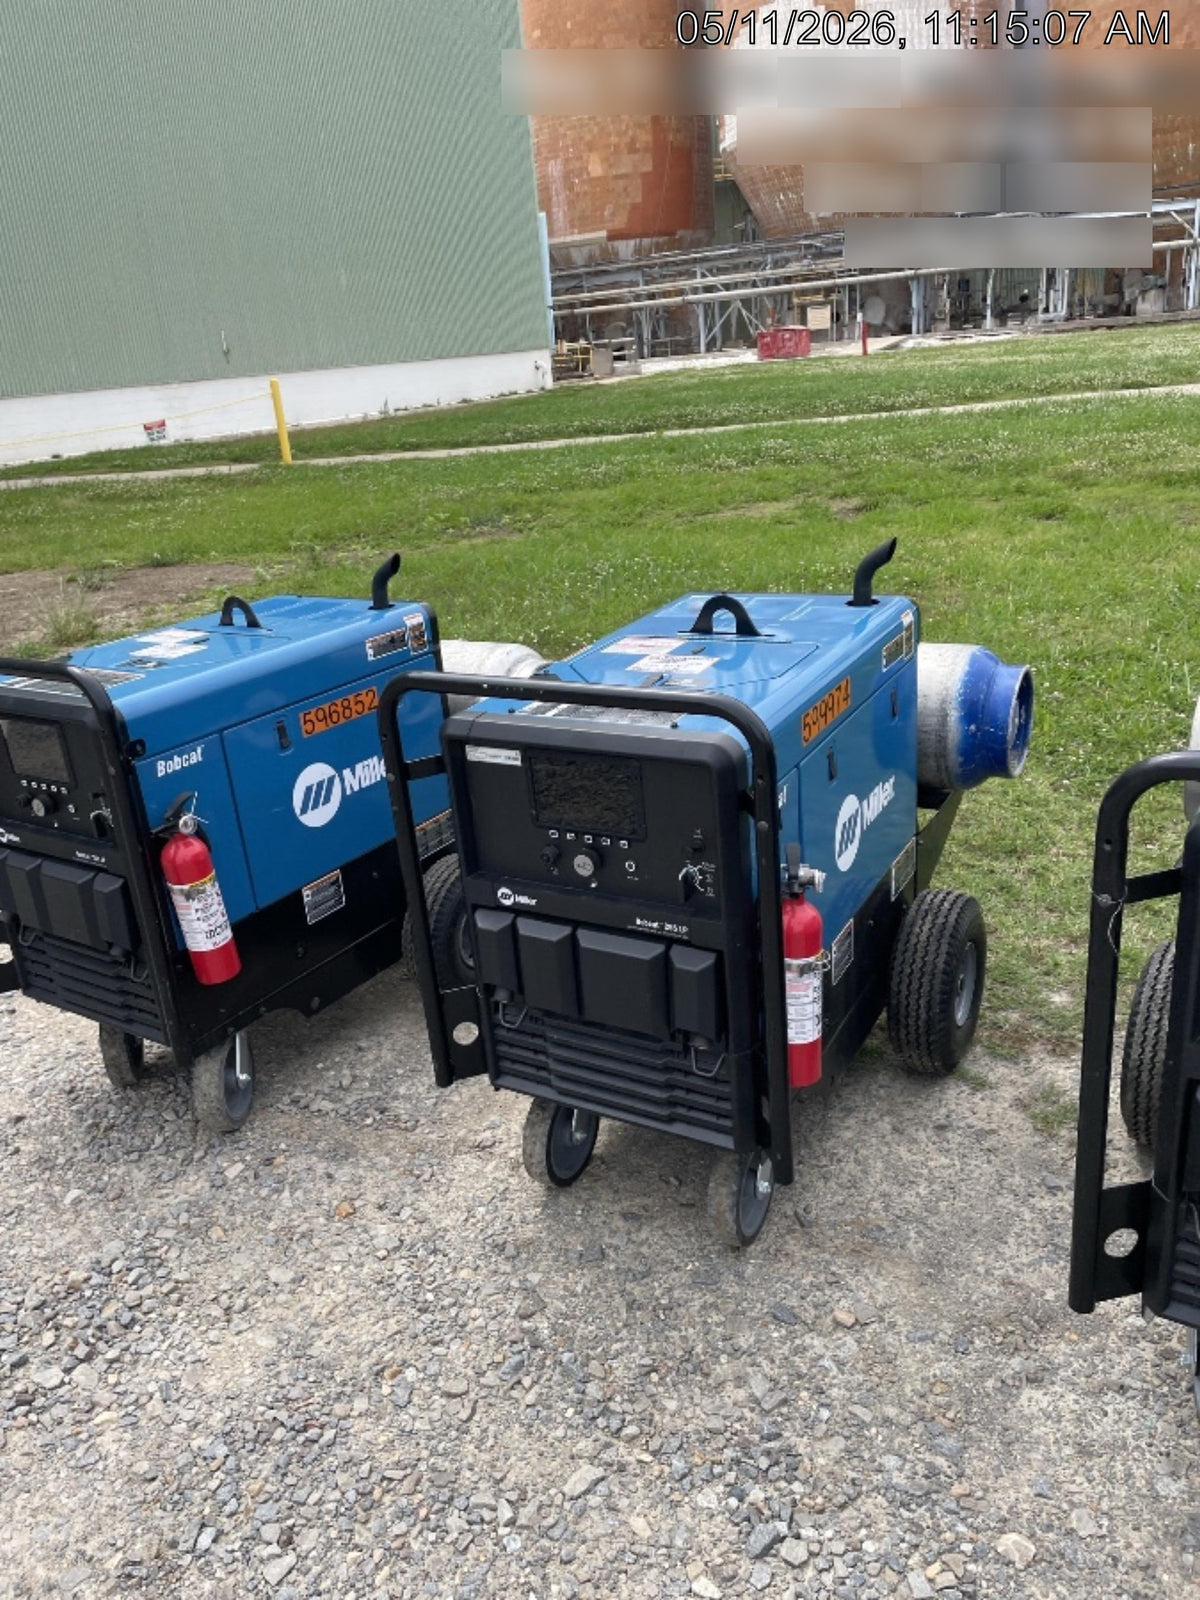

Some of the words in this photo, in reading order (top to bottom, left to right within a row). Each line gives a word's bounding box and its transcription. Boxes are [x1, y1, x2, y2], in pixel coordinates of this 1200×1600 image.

[302, 689, 379, 735] 596852
[156, 745, 203, 778] Bobcat
[342, 755, 387, 796] Mille
[862, 774, 896, 831] Miller
